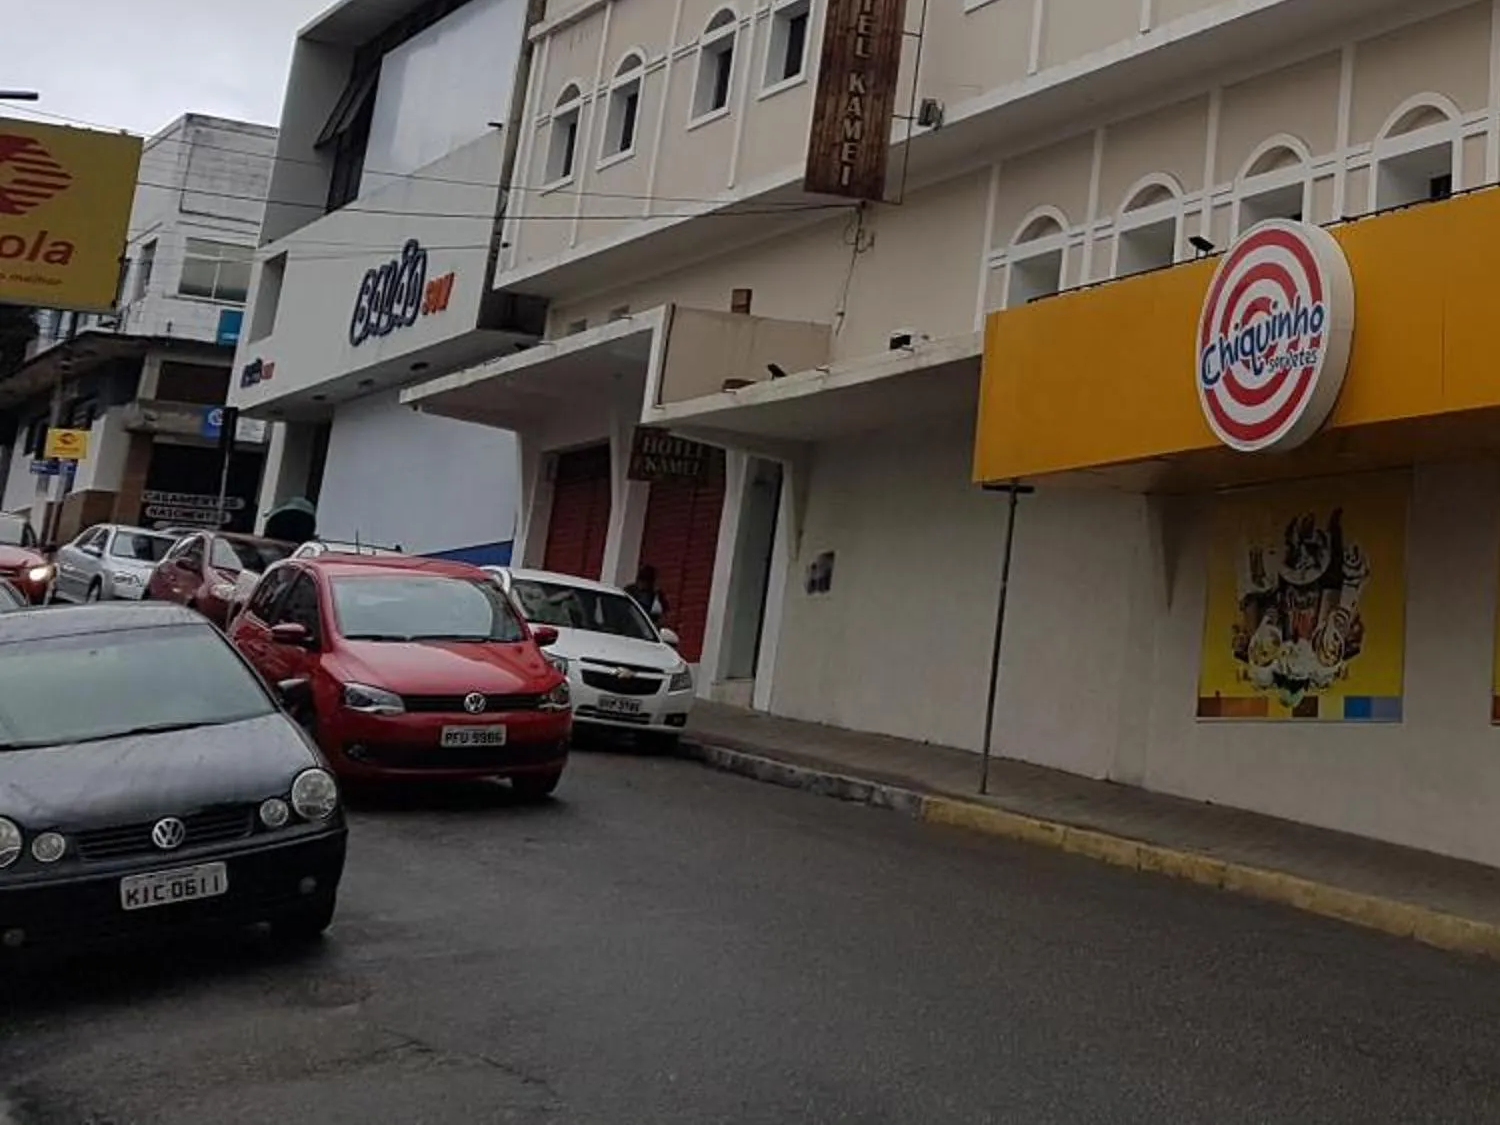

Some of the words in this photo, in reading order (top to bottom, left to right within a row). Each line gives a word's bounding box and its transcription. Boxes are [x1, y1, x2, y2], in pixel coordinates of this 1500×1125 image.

[841, 72, 866, 187] KAMEI
[1201, 295, 1325, 386] Chiquinho
[643, 436, 705, 460] HOTEL
